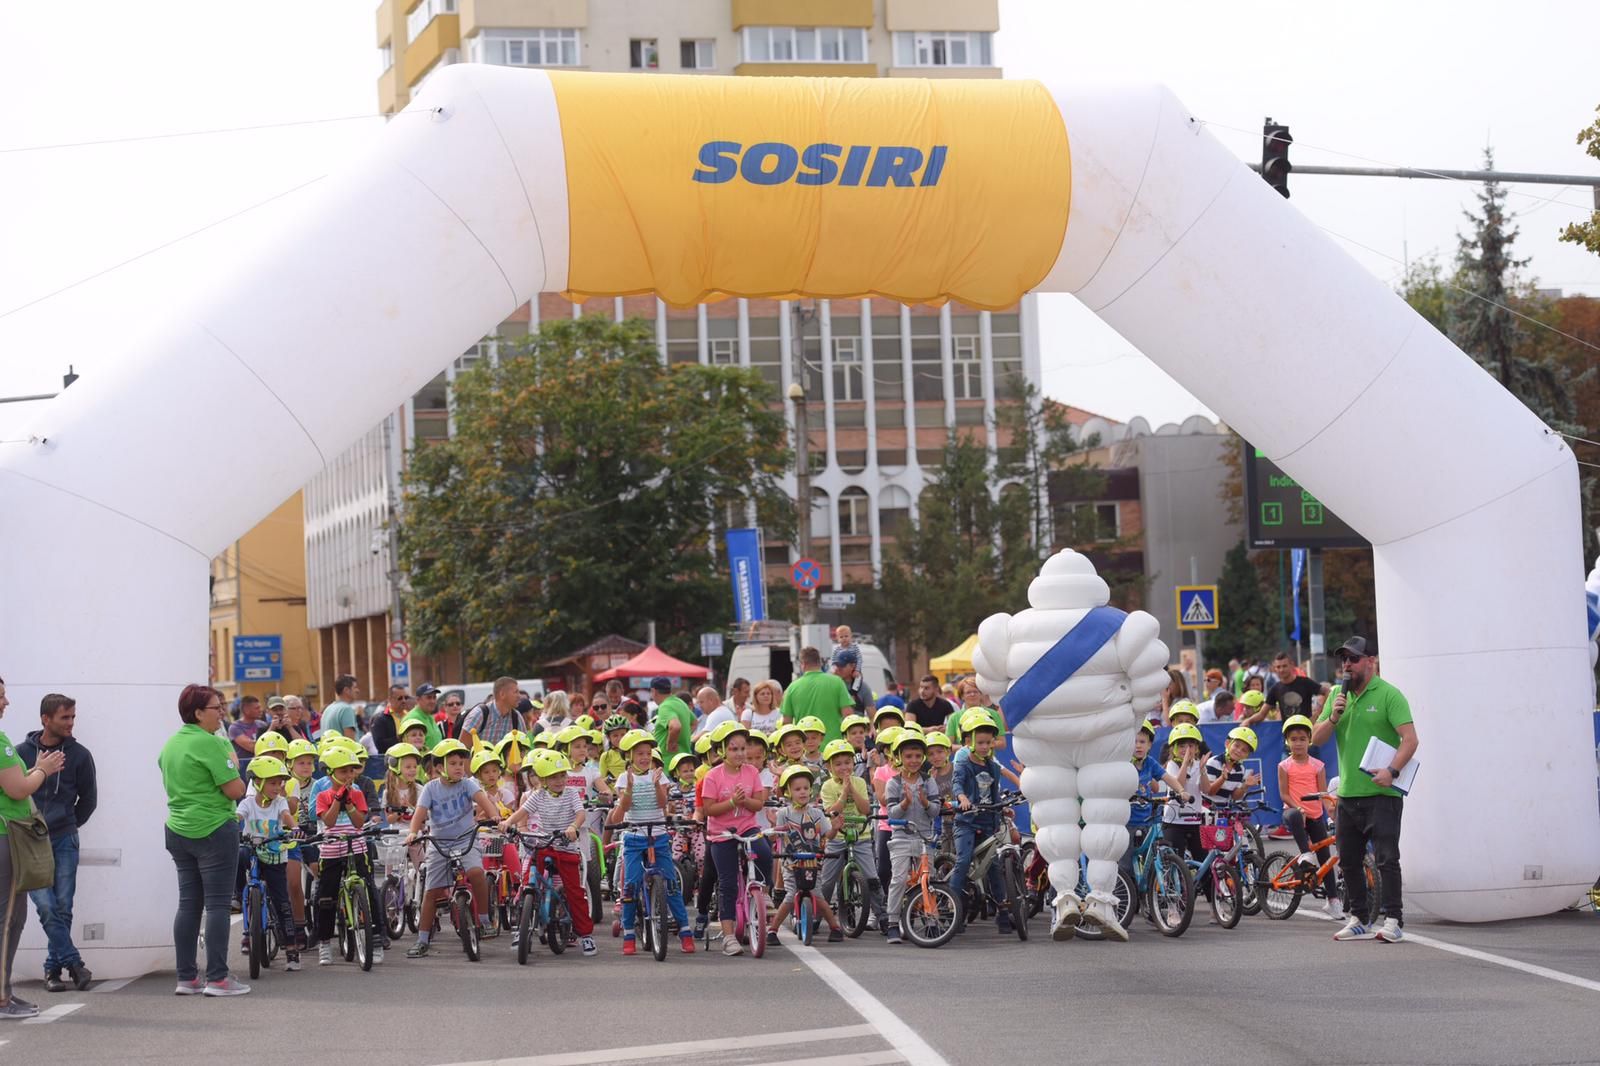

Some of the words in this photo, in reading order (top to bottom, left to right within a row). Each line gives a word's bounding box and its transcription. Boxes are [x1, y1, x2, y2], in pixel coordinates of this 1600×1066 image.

[692, 141, 948, 187] SOSIRI
[738, 559, 752, 622] MICHELIN
[394, 662, 406, 677] P
